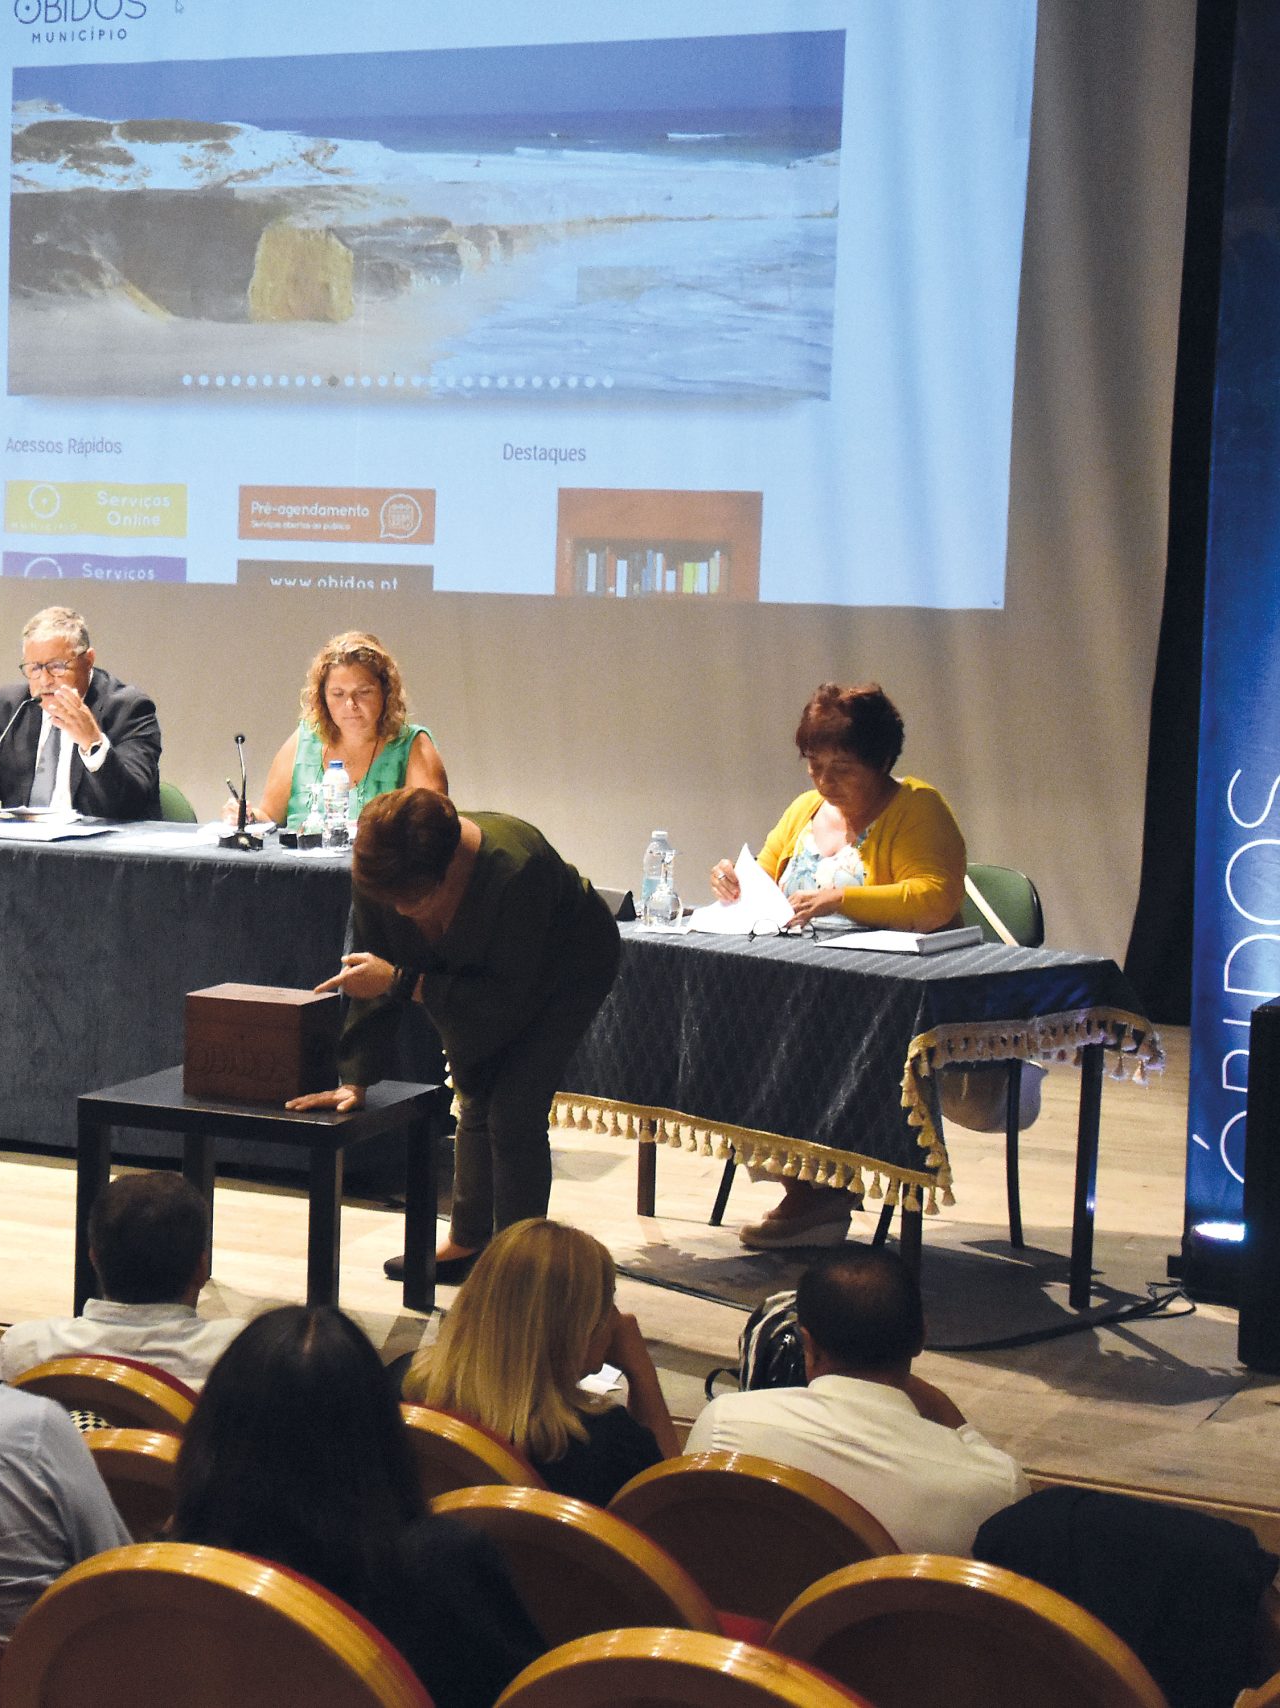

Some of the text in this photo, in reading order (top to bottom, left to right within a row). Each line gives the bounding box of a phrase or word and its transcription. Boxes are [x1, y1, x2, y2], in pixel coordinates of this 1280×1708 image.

[32, 26, 127, 43] MUNICÍPIO
[6, 437, 122, 457] Acessos Rápidos
[503, 442, 586, 465] Destaques
[96, 490, 171, 509] Serviços
[250, 501, 370, 518] Pré-agendamento
[107, 511, 161, 528] Online
